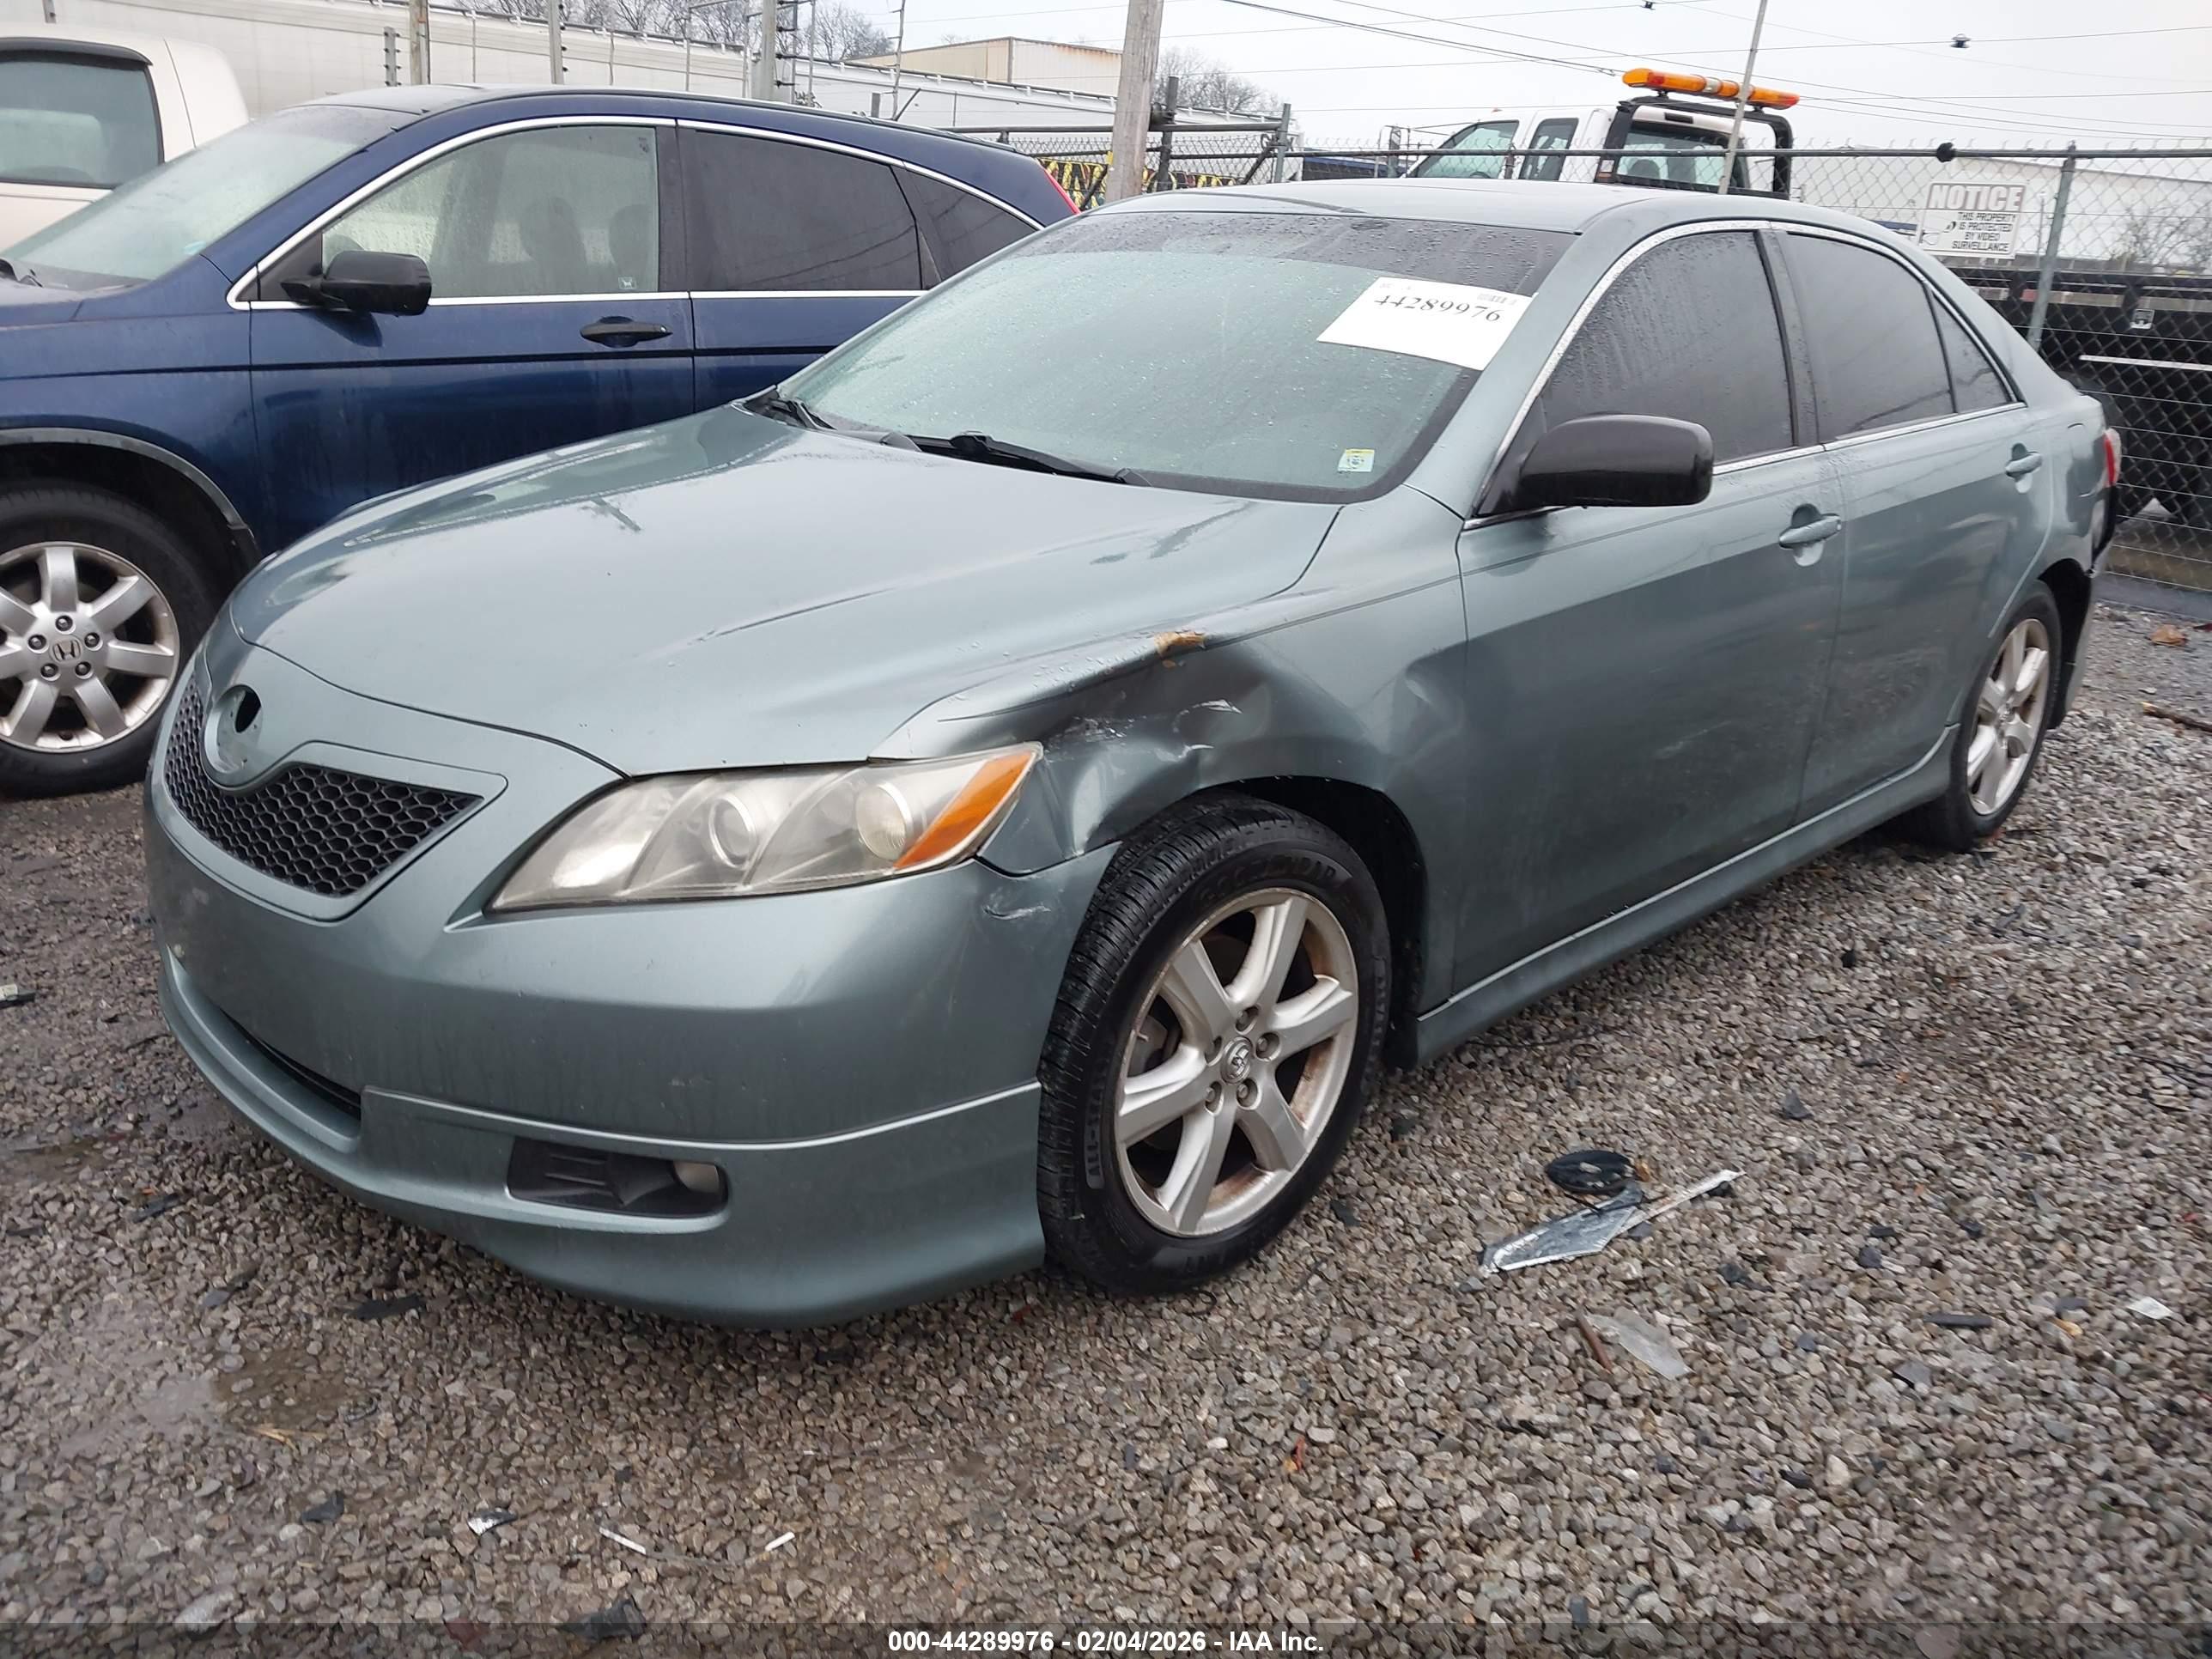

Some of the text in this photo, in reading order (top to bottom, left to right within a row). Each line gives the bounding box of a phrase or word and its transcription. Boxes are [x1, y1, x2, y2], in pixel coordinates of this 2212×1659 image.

[1929, 185, 2023, 211] NOTICE
[1958, 212, 2016, 222] THIS PROPERTY
[1959, 222, 2013, 232] IS PROTECTED
[1965, 232, 2001, 241] BY VIDEO
[1952, 240, 2009, 252] SURVEILLANCE
[1374, 295, 1502, 322] 44289976
